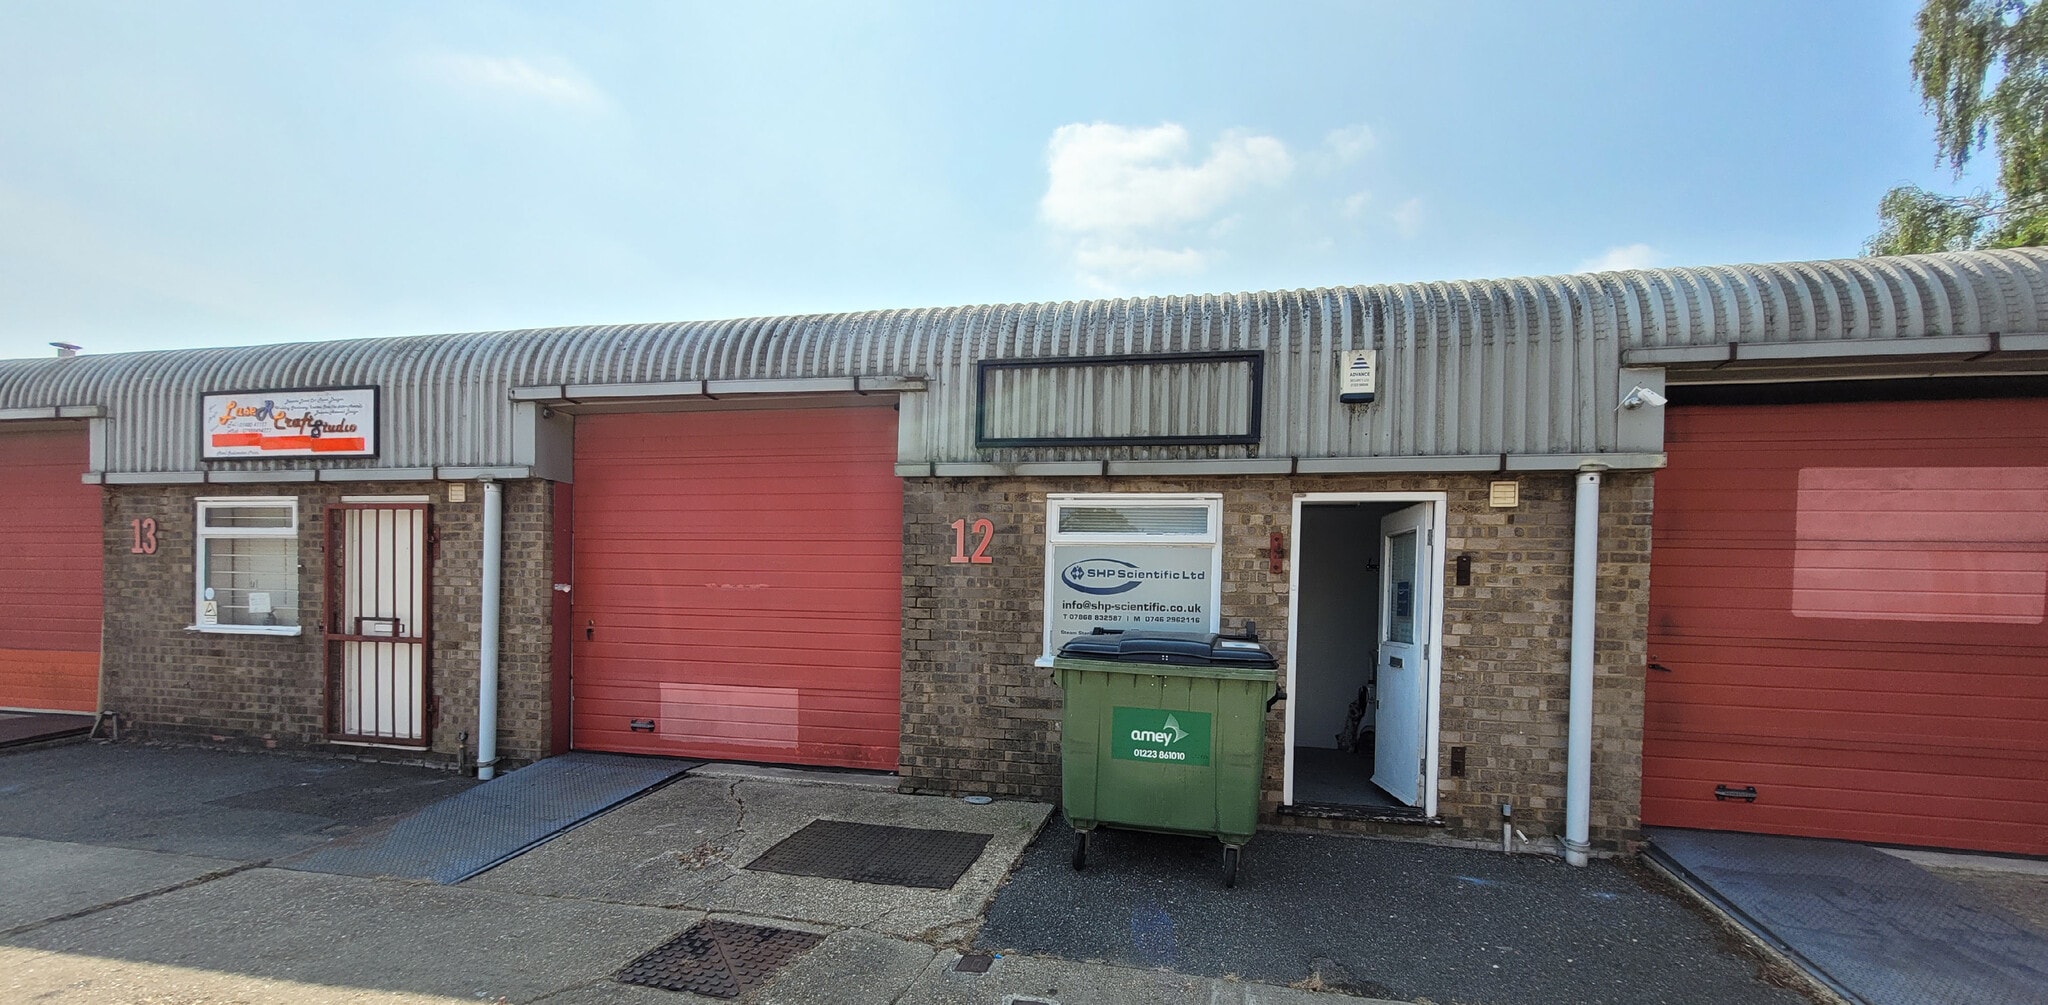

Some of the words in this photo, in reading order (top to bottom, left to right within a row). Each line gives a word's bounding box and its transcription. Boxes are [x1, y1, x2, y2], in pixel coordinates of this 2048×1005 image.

[219, 400, 275, 426] LaseR
[273, 411, 314, 435] Craft
[311, 417, 357, 438] Studio
[131, 518, 157, 554] 13
[950, 518, 994, 564] 12
[1087, 569, 1116, 578] SHP
[1117, 569, 1180, 580] Scientific
[1182, 571, 1205, 580] Ltd
[1062, 600, 1202, 613] info@shp-scientific.co.uk
[1130, 729, 1173, 747] amey
[1133, 748, 1158, 759] 01223
[1158, 750, 1186, 760] 861010
